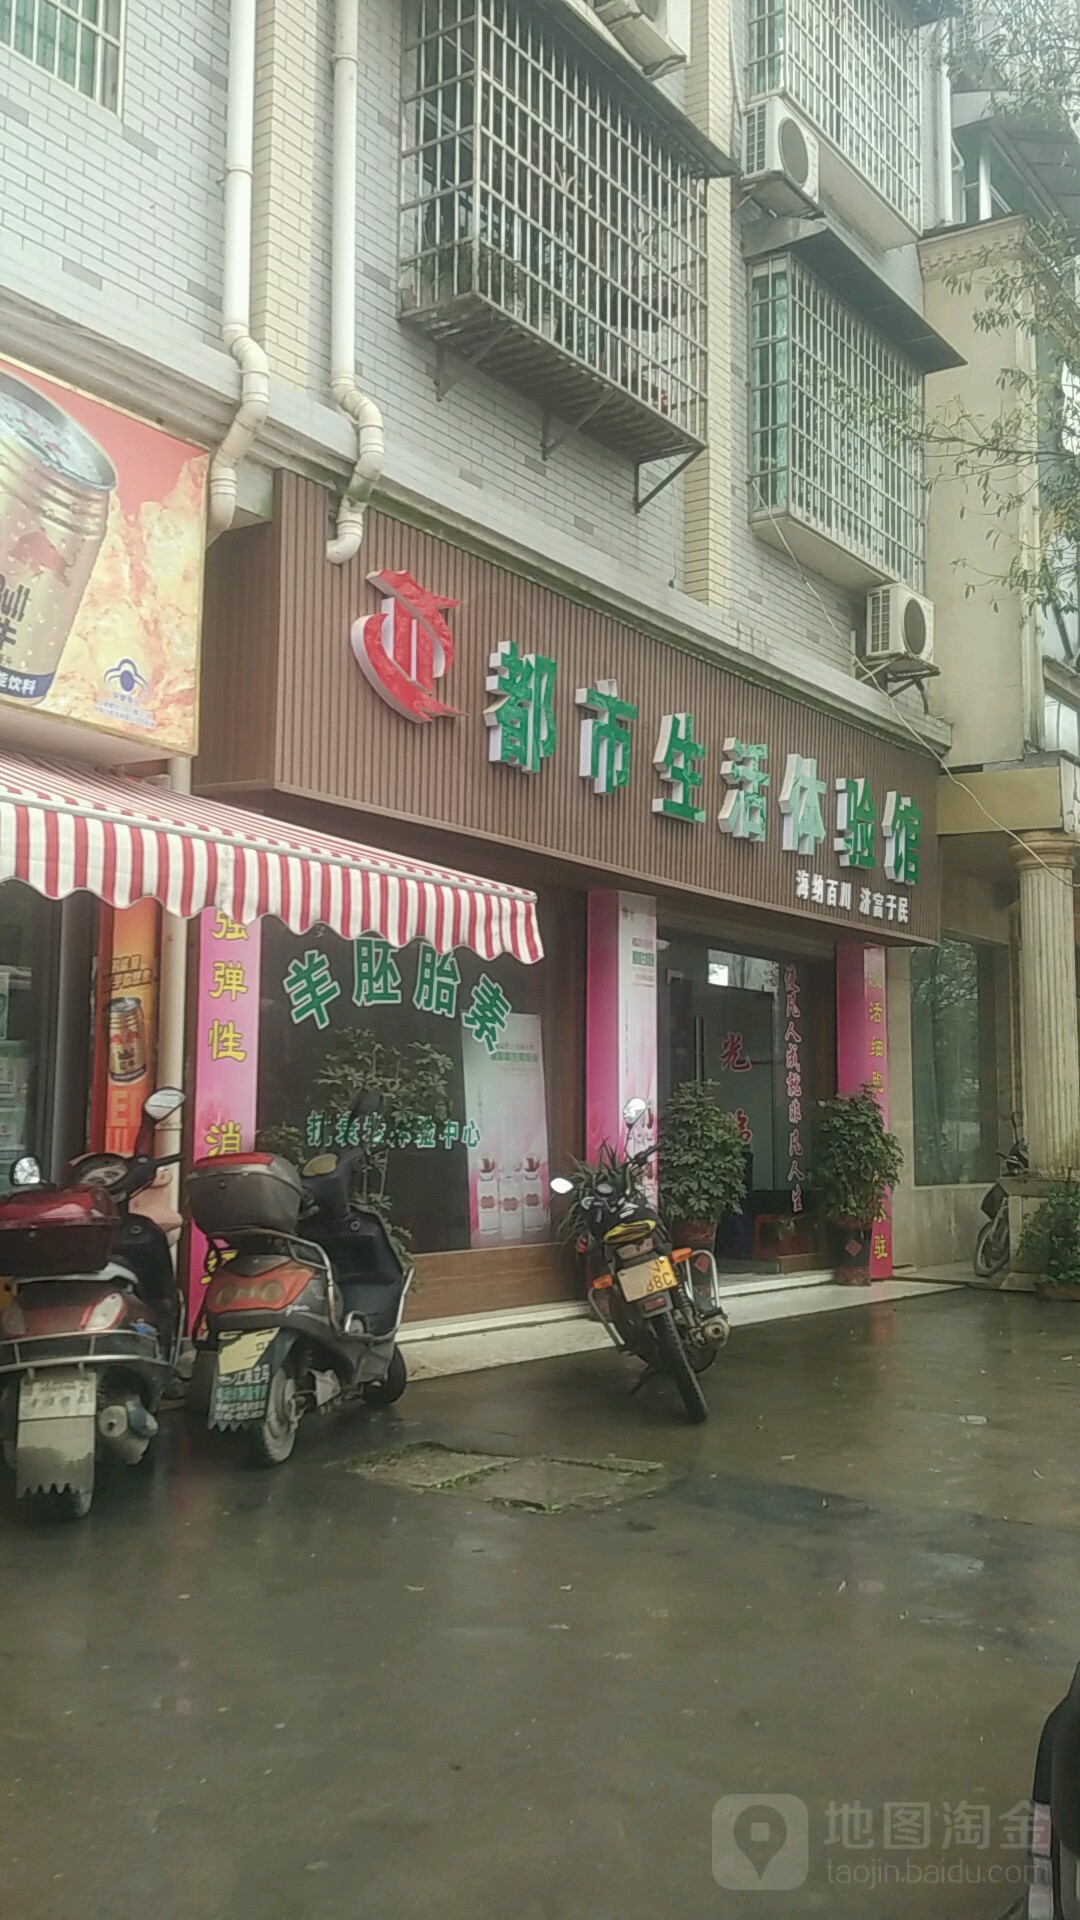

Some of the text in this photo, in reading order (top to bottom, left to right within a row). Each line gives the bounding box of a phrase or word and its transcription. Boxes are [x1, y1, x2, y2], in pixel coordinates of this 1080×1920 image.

[483, 640, 923, 886] 都市生活体验馆
[796, 869, 909, 924] 海纳百川 济富于民
[283, 937, 512, 1055] 羊胚胎素
[784, 963, 805, 1213] 使凡人成就非凡人生
